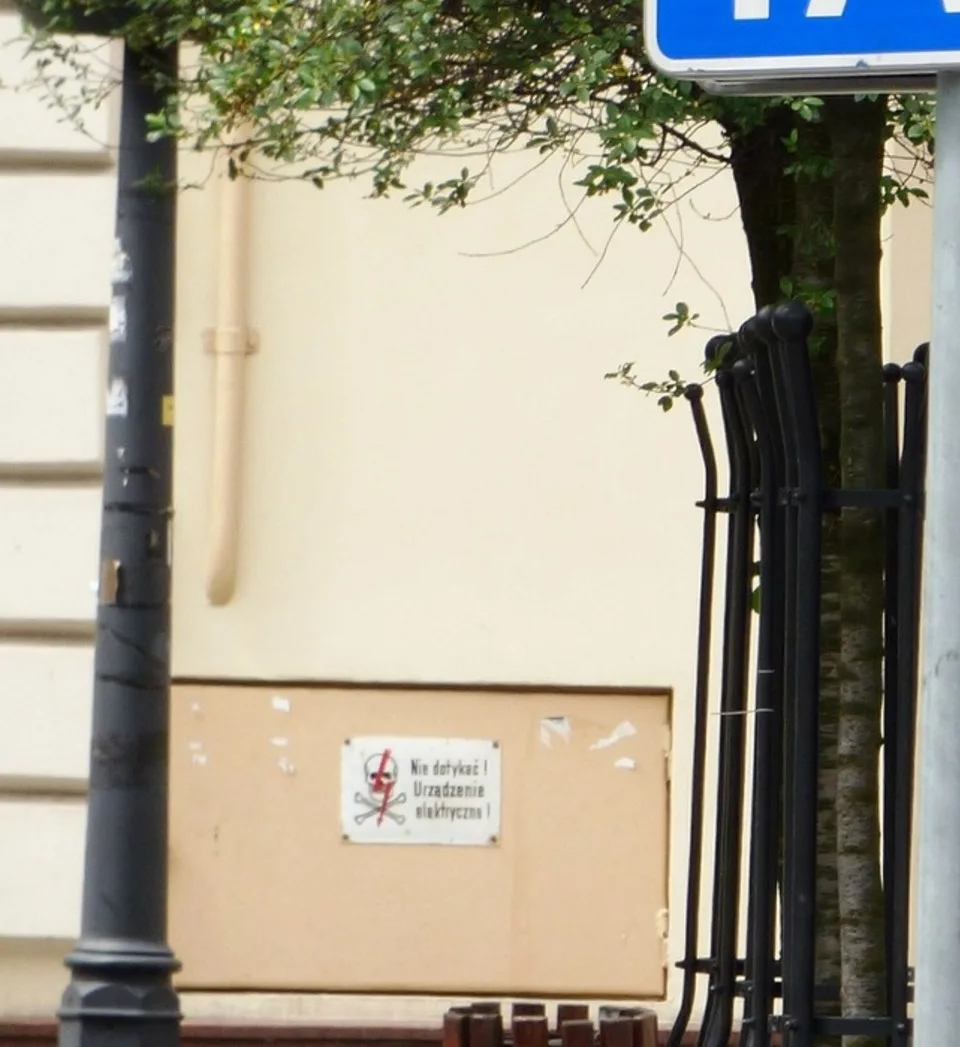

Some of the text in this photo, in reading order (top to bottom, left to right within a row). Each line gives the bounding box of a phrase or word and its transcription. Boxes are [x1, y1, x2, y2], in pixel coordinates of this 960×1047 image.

[410, 758, 429, 776] Nie
[433, 758, 480, 779] dotykać
[413, 779, 485, 799] Urządzenie
[415, 801, 483, 823] elektryczne
